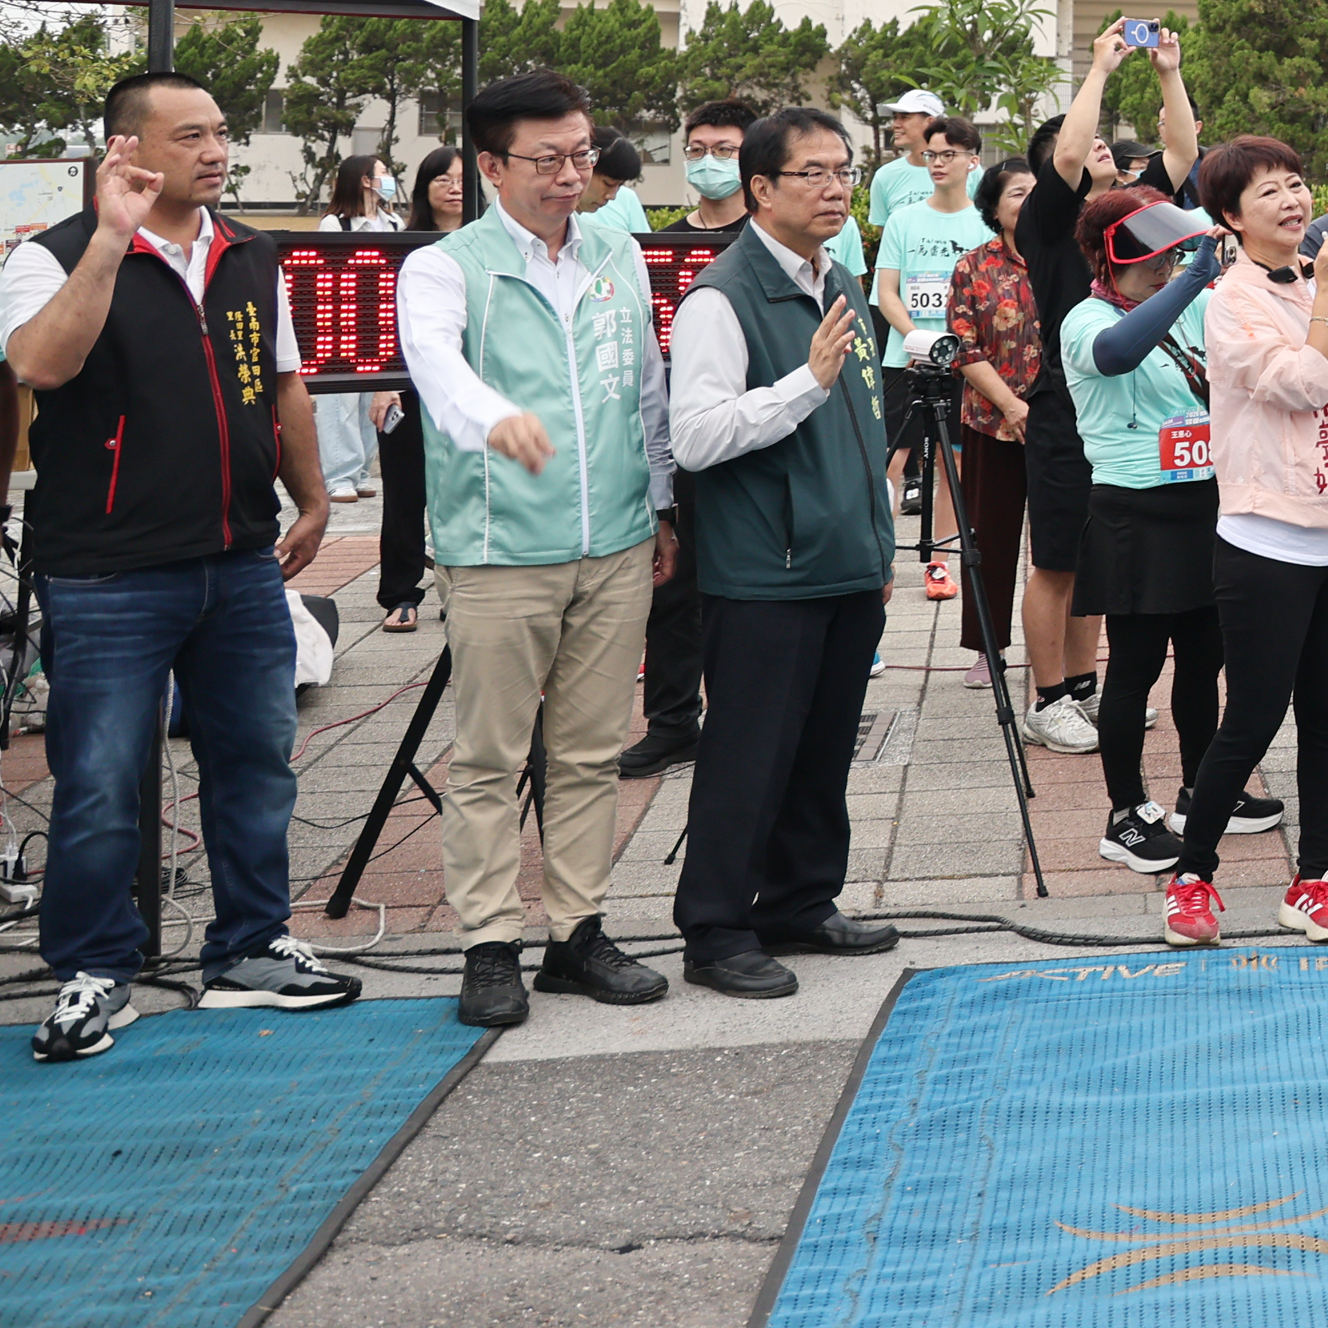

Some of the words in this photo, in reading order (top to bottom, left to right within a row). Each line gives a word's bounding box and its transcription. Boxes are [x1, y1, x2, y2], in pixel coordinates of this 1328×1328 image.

[246, 301, 263, 392] 臺南市官田區
[591, 308, 621, 404] 郭國文
[619, 306, 634, 387] 立法委員
[1173, 439, 1213, 467] 50
